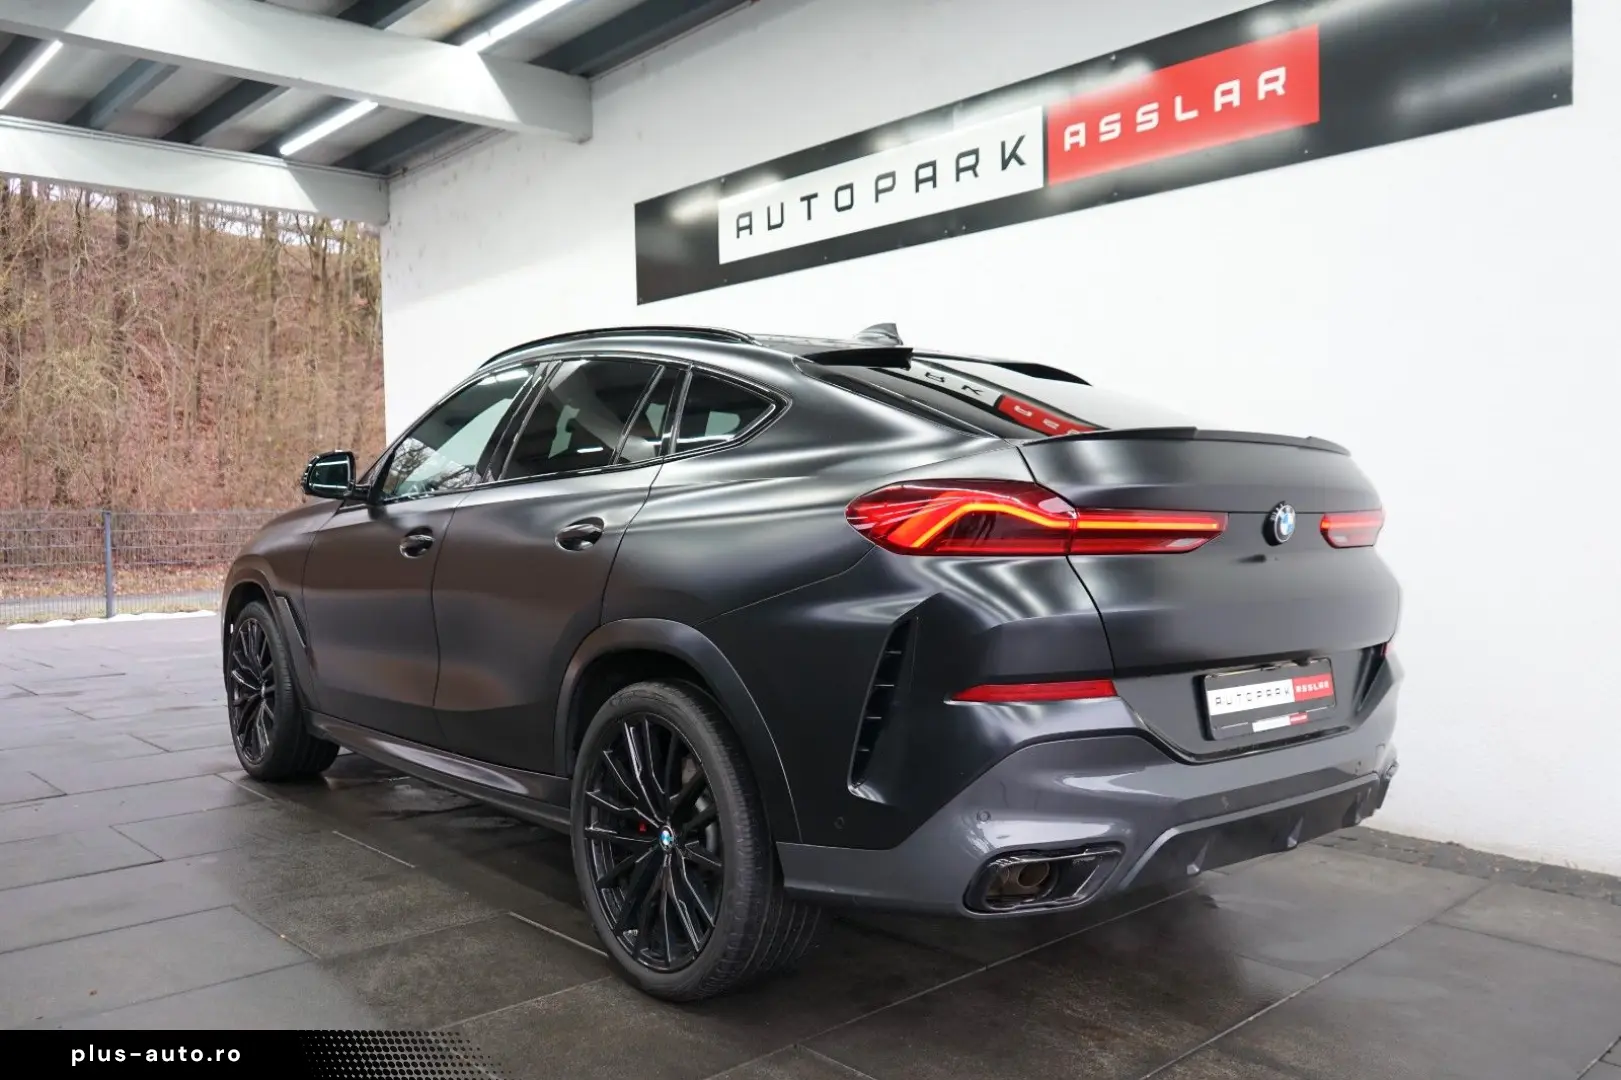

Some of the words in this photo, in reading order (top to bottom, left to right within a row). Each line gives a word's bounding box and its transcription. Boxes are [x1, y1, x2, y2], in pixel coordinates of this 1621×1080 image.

[735, 134, 1027, 239] AUTOPARK
[1063, 66, 1288, 152] ASSLAR
[1215, 687, 1290, 705] AUTOPARK
